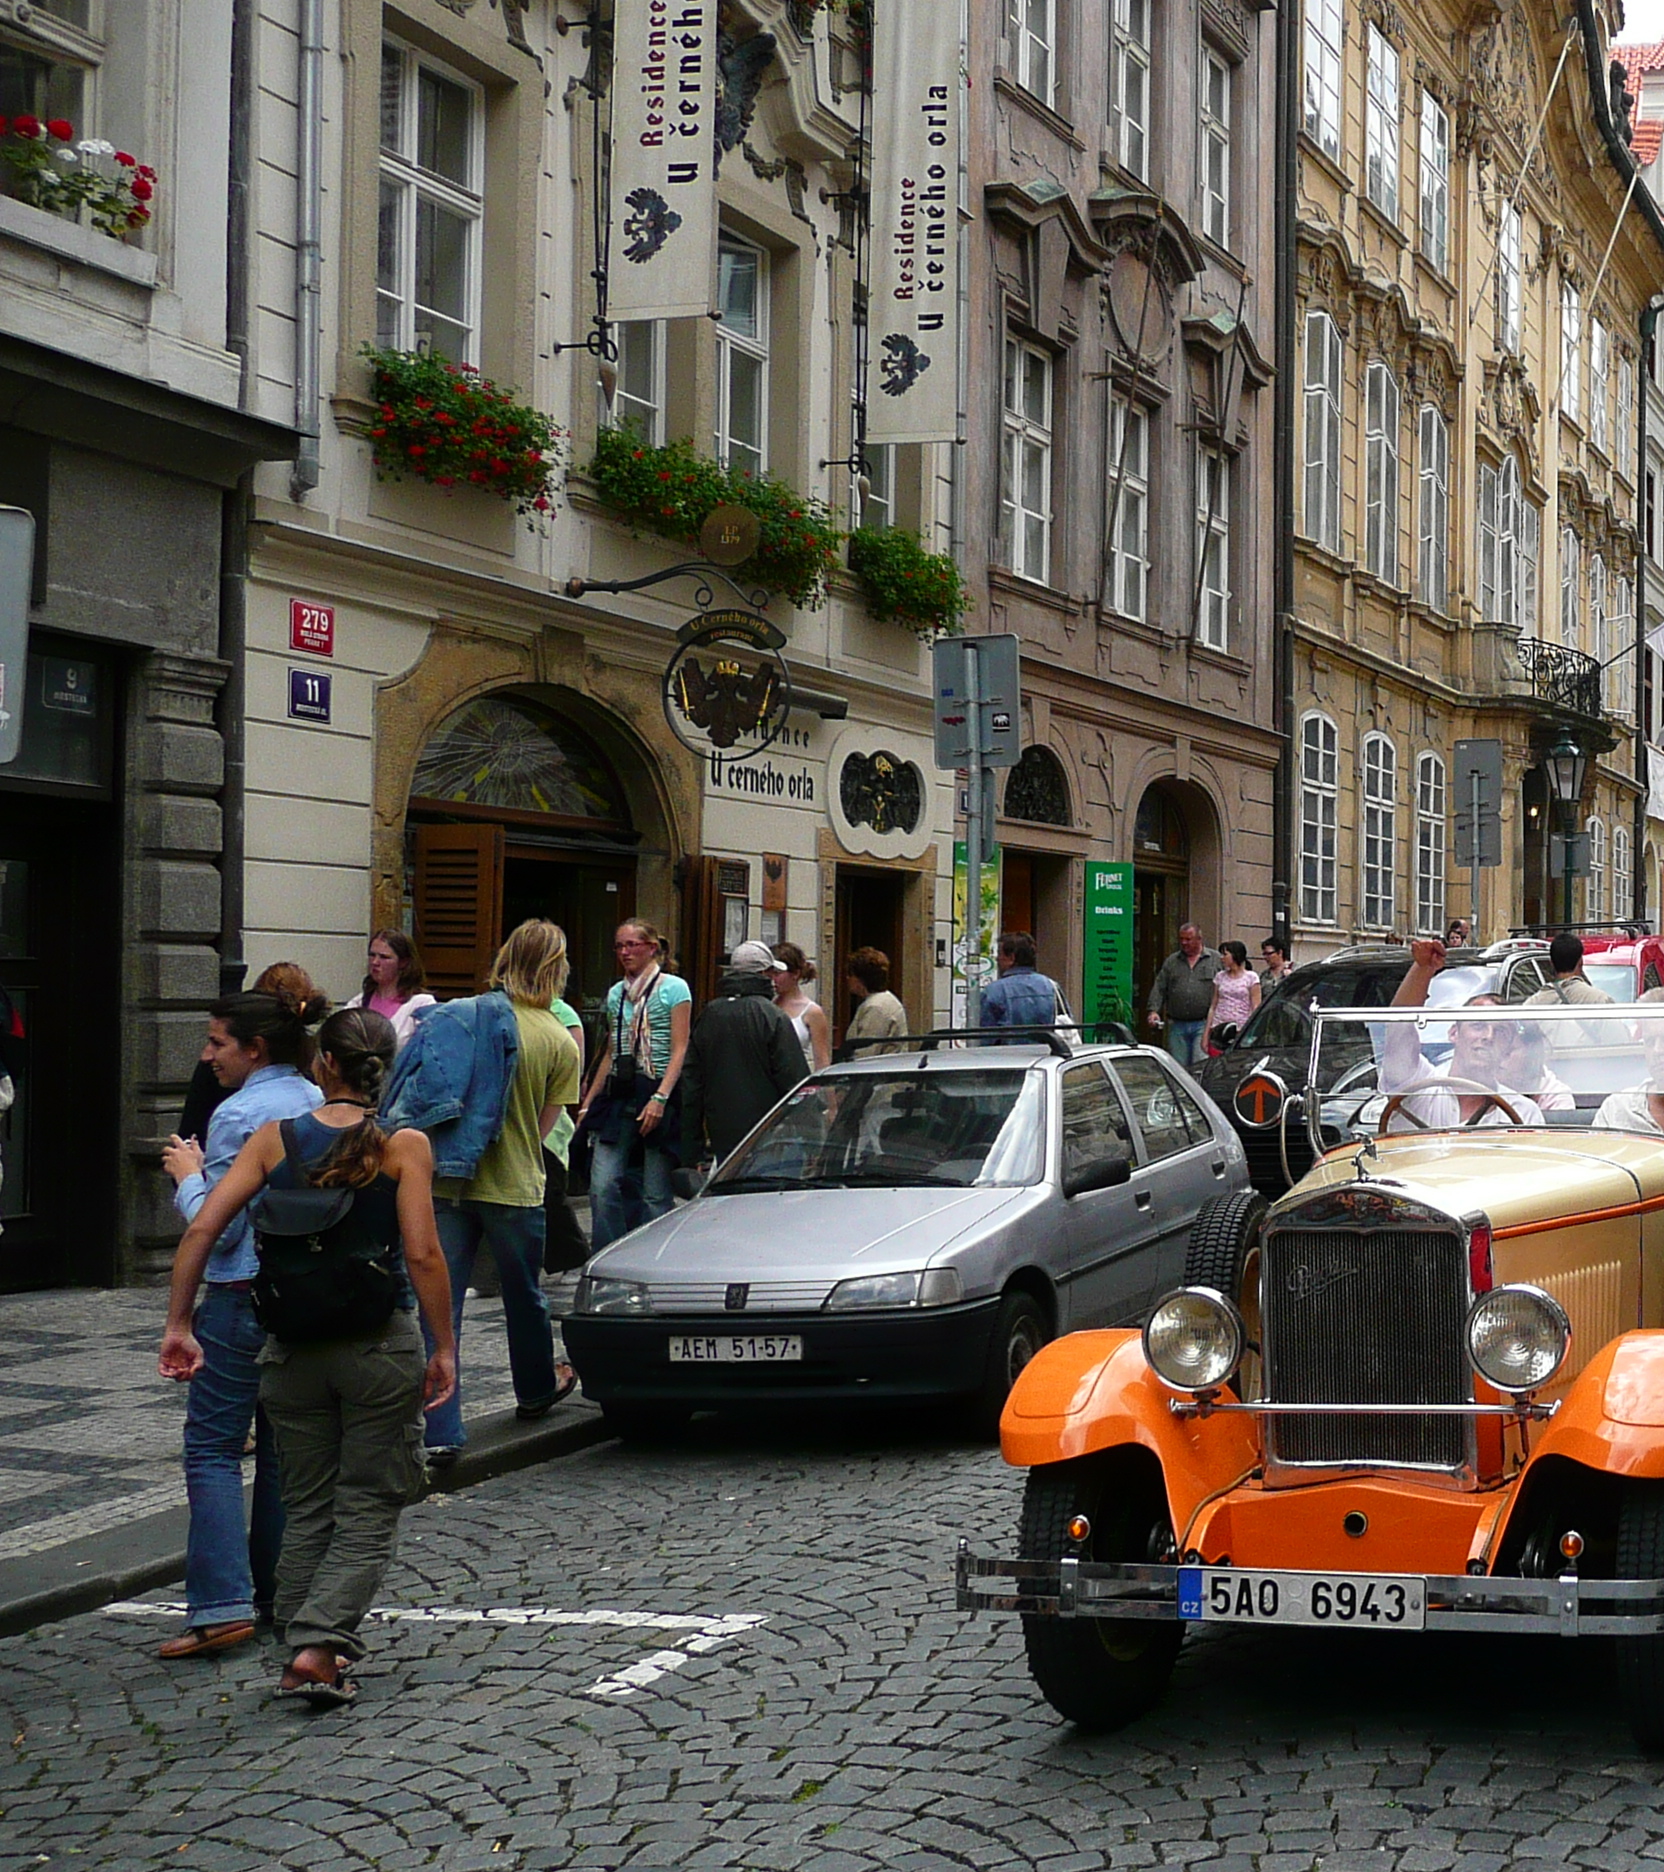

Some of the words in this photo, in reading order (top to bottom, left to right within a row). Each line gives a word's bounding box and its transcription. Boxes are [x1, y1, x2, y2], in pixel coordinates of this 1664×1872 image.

[640, 0, 667, 147] Residence
[669, 0, 703, 137] černéh
[922, 85, 948, 147] orla
[893, 176, 915, 301] Residence
[917, 164, 946, 292] černého
[302, 608, 329, 632] 279
[66, 667, 77, 690] 9
[306, 678, 319, 703] 11
[711, 751, 722, 787] U
[788, 767, 814, 801] orla
[1095, 906, 1123, 915] Drinks
[681, 1337, 718, 1359] AEM
[732, 1336, 790, 1359] 51-57
[1181, 1601, 1199, 1614] CZ
[1311, 1581, 1405, 1622] 6943
